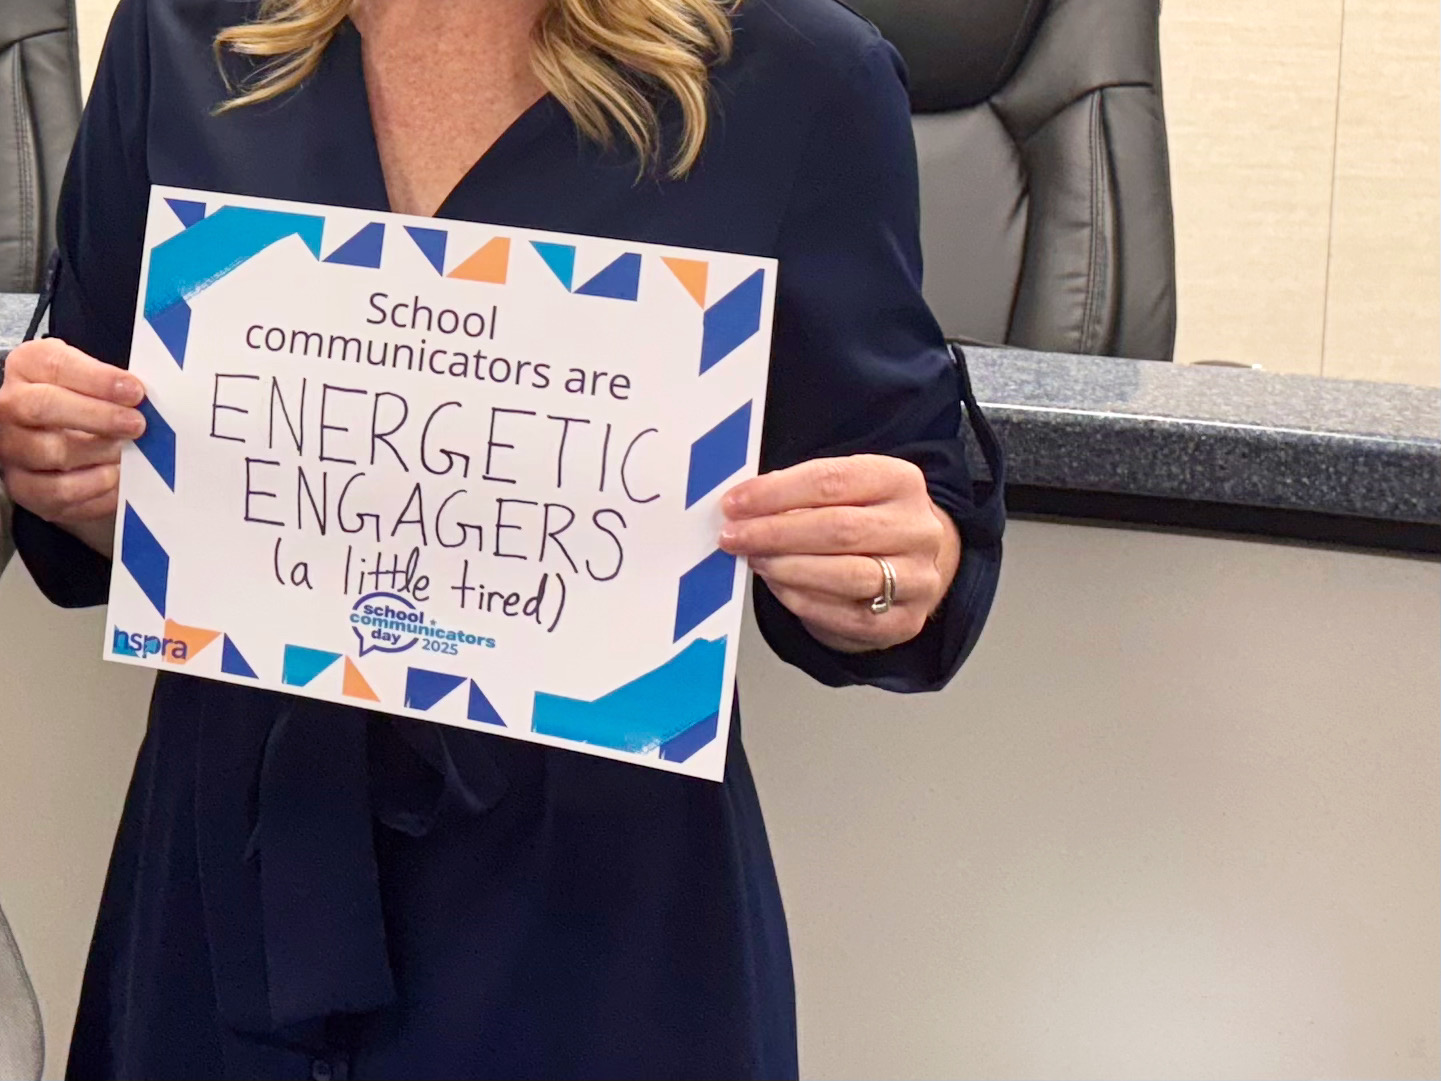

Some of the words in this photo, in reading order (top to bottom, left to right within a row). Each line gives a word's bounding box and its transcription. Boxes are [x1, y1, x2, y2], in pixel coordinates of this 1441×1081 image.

[366, 291, 498, 340] School
[244, 322, 551, 391] communicators
[563, 366, 632, 401] are
[209, 372, 662, 505] ENERGETIC
[243, 456, 628, 583] ENGAGERS
[274, 537, 313, 590] (a
[343, 545, 430, 602] little
[450, 559, 566, 633] tired)
[349, 612, 497, 649] communicators
[362, 603, 425, 625] school
[112, 628, 188, 660] nspra
[370, 628, 402, 646] day
[421, 637, 459, 656] 2025
